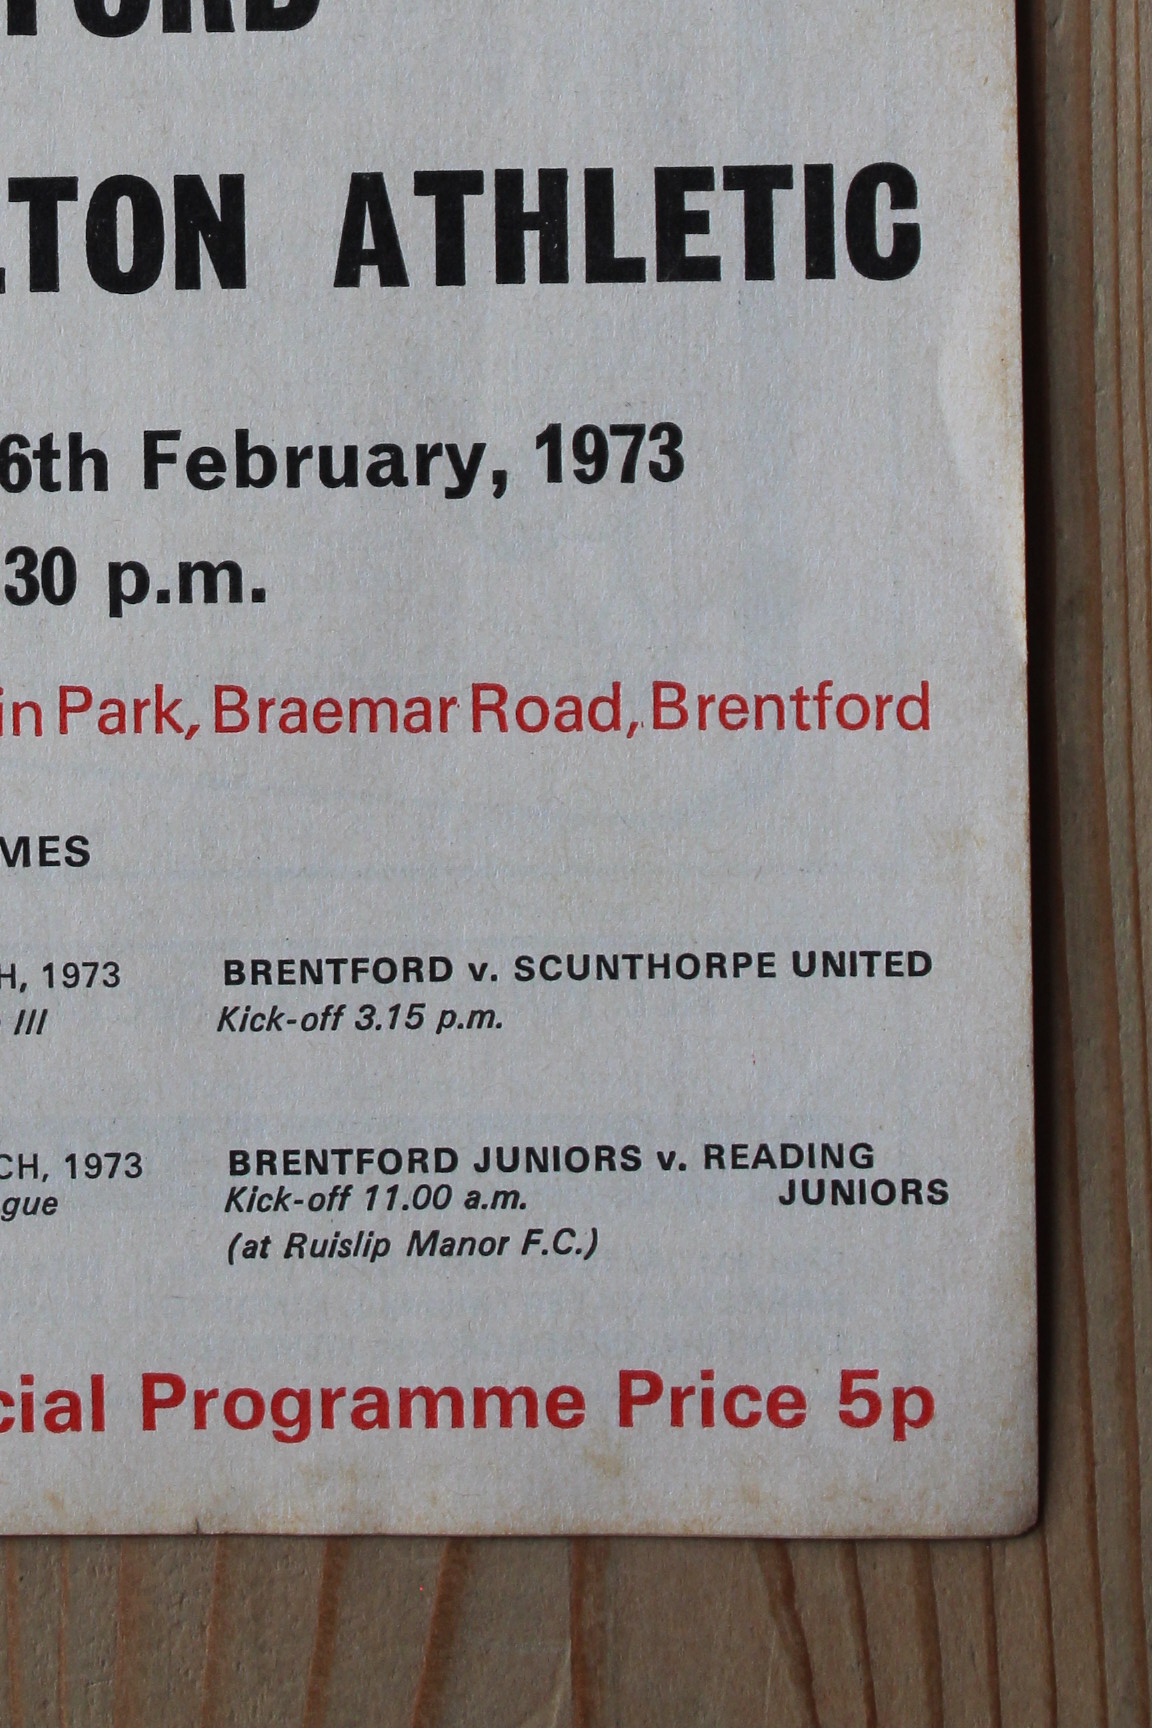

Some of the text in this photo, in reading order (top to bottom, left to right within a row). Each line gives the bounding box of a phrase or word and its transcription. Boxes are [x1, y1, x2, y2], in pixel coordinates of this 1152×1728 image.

[332, 160, 923, 290] ATHLETIC
[142, 427, 509, 501] February,
[534, 420, 686, 486] 1973
[107, 559, 267, 620] p.m.
[57, 681, 201, 741] Park,
[213, 683, 459, 736] Braemar
[470, 679, 639, 739] Road,
[651, 678, 931, 732] Brentford
[41, 960, 122, 990] 1973
[223, 949, 934, 987] BRENTFORD v. SCUNTHORPE UNITED
[12, 1007, 50, 1037] III
[215, 1001, 504, 1036] Kick-off 3.15 p.m.
[63, 1150, 144, 1181] 1973
[228, 1141, 875, 1178] BRENTFORD JUNIORS v. READING
[223, 1182, 528, 1214] Kick-off 11.00 a.m.
[777, 1177, 950, 1208] JUNIORS
[226, 1226, 599, 1267] (at Ruislip Manor F.C.)
[140, 1370, 587, 1445] Programme
[617, 1367, 808, 1429] Price
[837, 1367, 936, 1443] 5p
